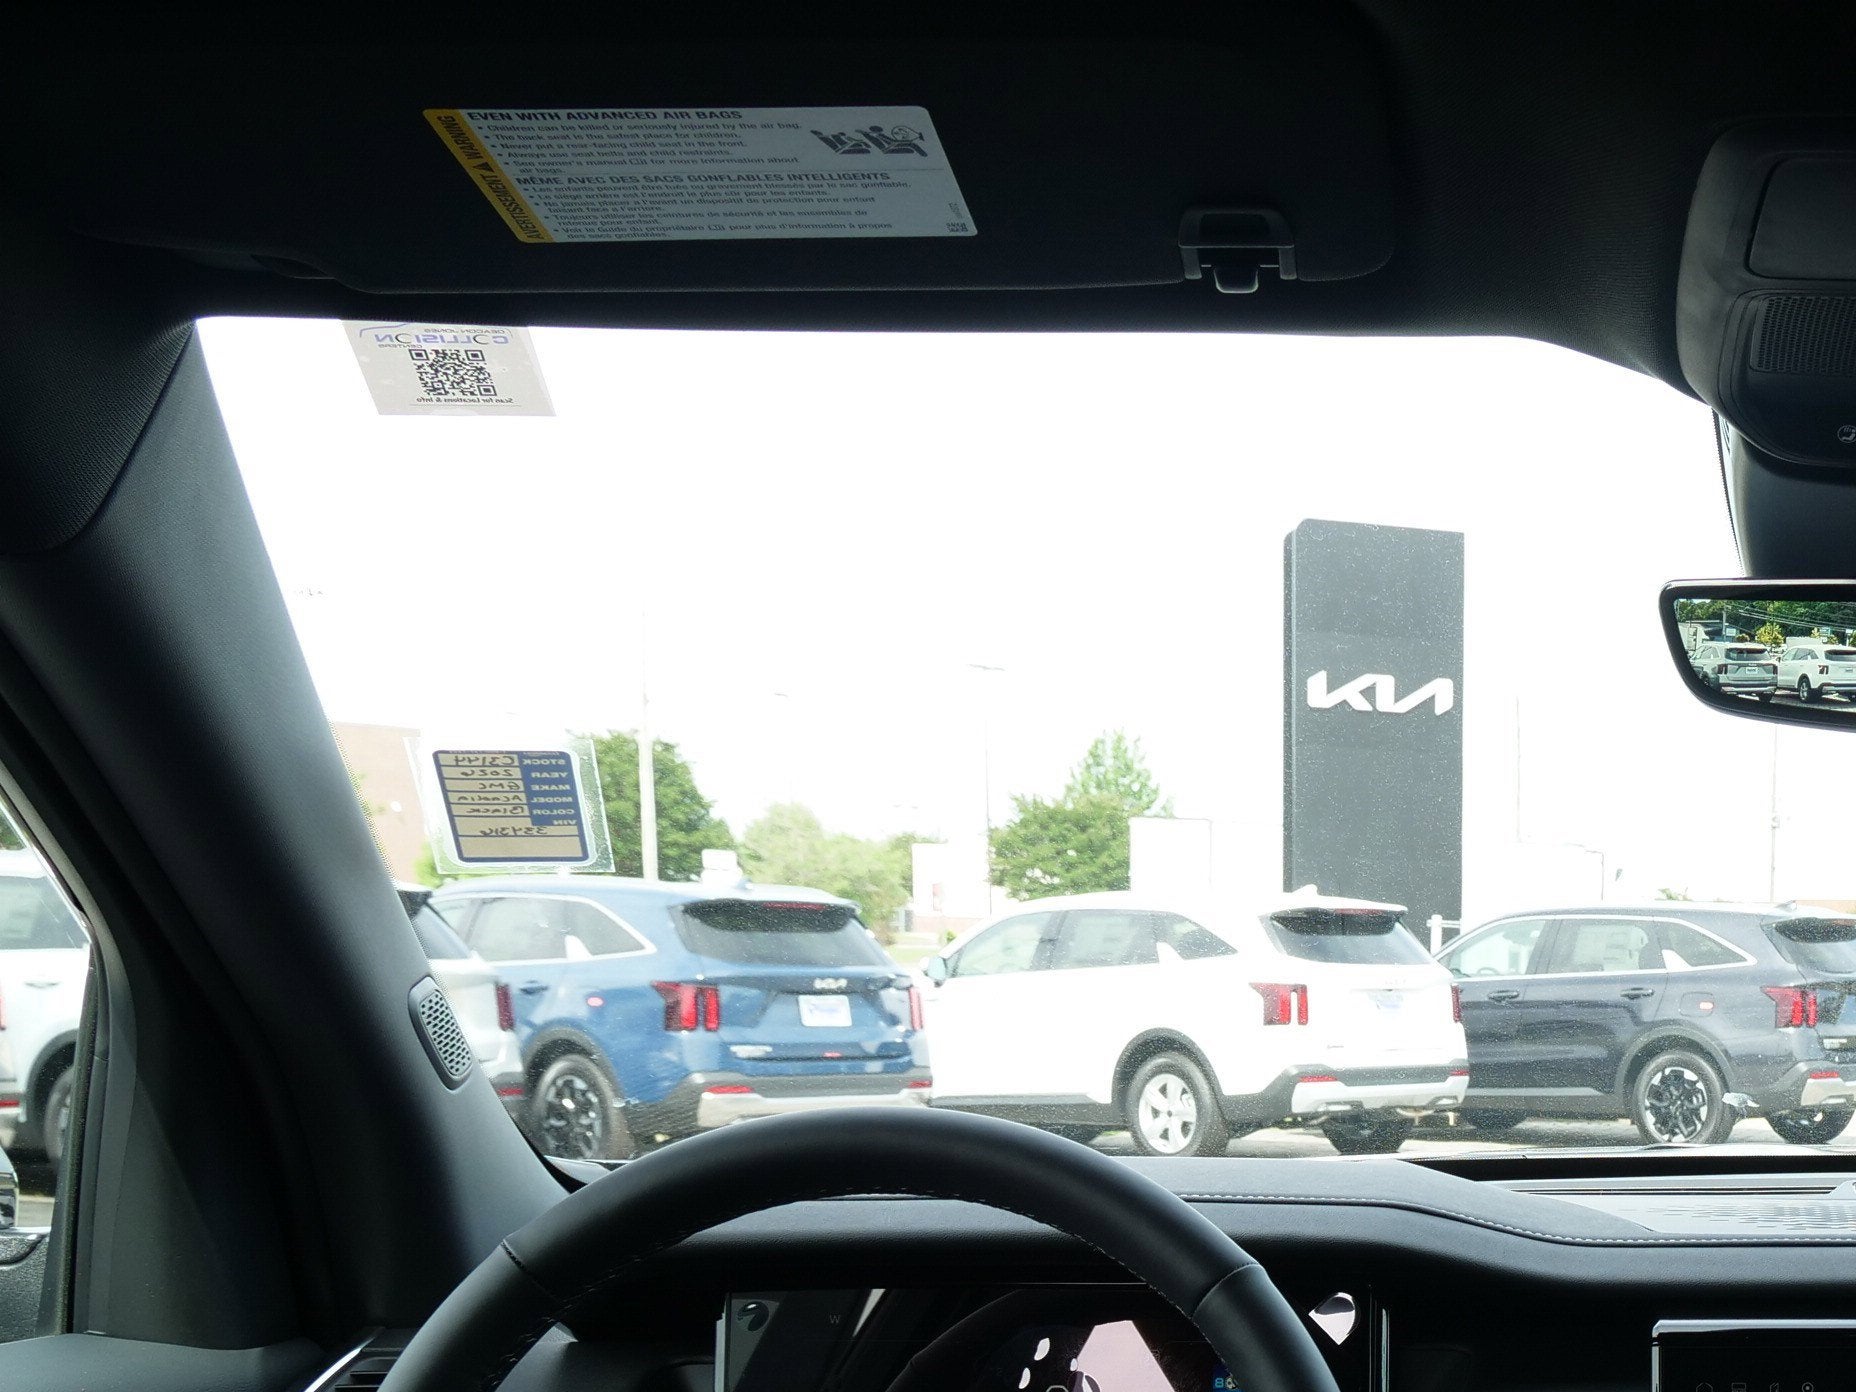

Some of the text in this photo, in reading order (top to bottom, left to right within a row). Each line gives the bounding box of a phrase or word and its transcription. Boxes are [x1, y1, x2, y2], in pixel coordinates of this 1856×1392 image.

[467, 111, 742, 120] EVEN WITH ADVANCED AIR BAGS
[436, 115, 484, 161] WARNING
[567, 176, 608, 185] AVEC
[612, 176, 641, 184] DES
[644, 175, 684, 184] SACS
[787, 173, 890, 182] INTELLIGENTS
[1307, 670, 1454, 716] KIA
